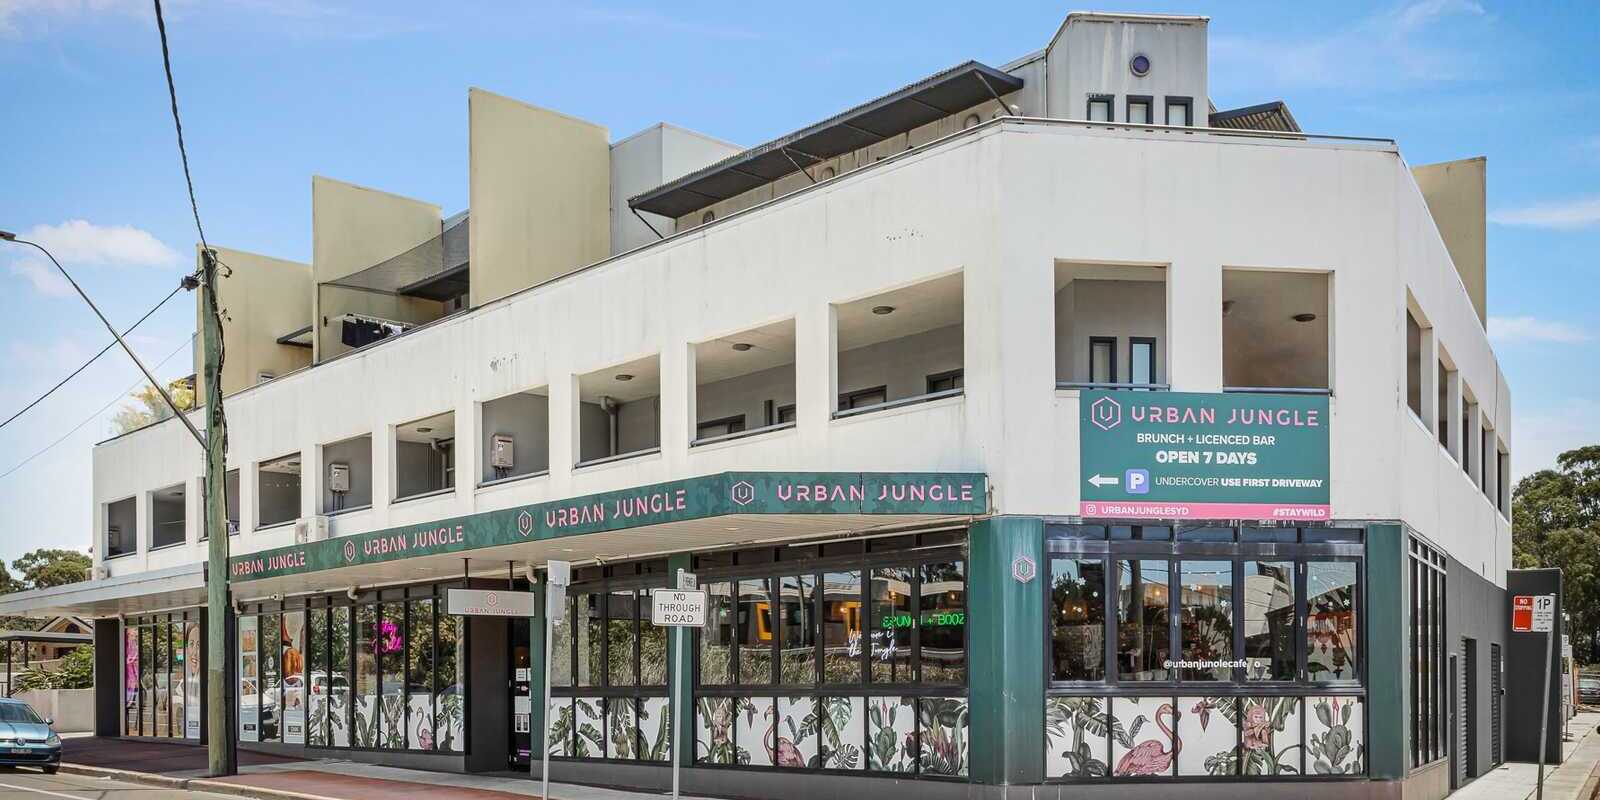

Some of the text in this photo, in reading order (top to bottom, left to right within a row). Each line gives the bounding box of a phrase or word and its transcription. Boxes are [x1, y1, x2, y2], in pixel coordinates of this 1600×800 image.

[1131, 405, 1215, 424] URBAN
[1227, 408, 1319, 426] JUNGLE
[1137, 432, 1184, 444] BRUNCH
[1196, 434, 1250, 445] LICENCED
[1252, 435, 1275, 446] BAR
[1155, 450, 1257, 465] OPEN 7 DAYS
[1155, 476, 1219, 487] UNDERCOVER
[1221, 478, 1241, 487] USE
[1243, 478, 1271, 488] FIRST
[1272, 479, 1323, 488] DRIVEWAY
[777, 484, 865, 501] URBAN
[878, 484, 973, 501] JUNGLE
[546, 503, 604, 528] URBAN
[613, 489, 687, 519] JUNGLE
[1101, 505, 1189, 516] URBANJUNGLESYD
[1272, 507, 1325, 518] #STAYWILD
[364, 534, 406, 555] URBAN
[412, 525, 464, 548] JUNGLE
[231, 551, 306, 576] URBAN JUNGLE
[673, 593, 686, 601] NO
[659, 603, 701, 612] THROUGH
[1537, 598, 1551, 610] 1P
[664, 614, 694, 623] ROAD
